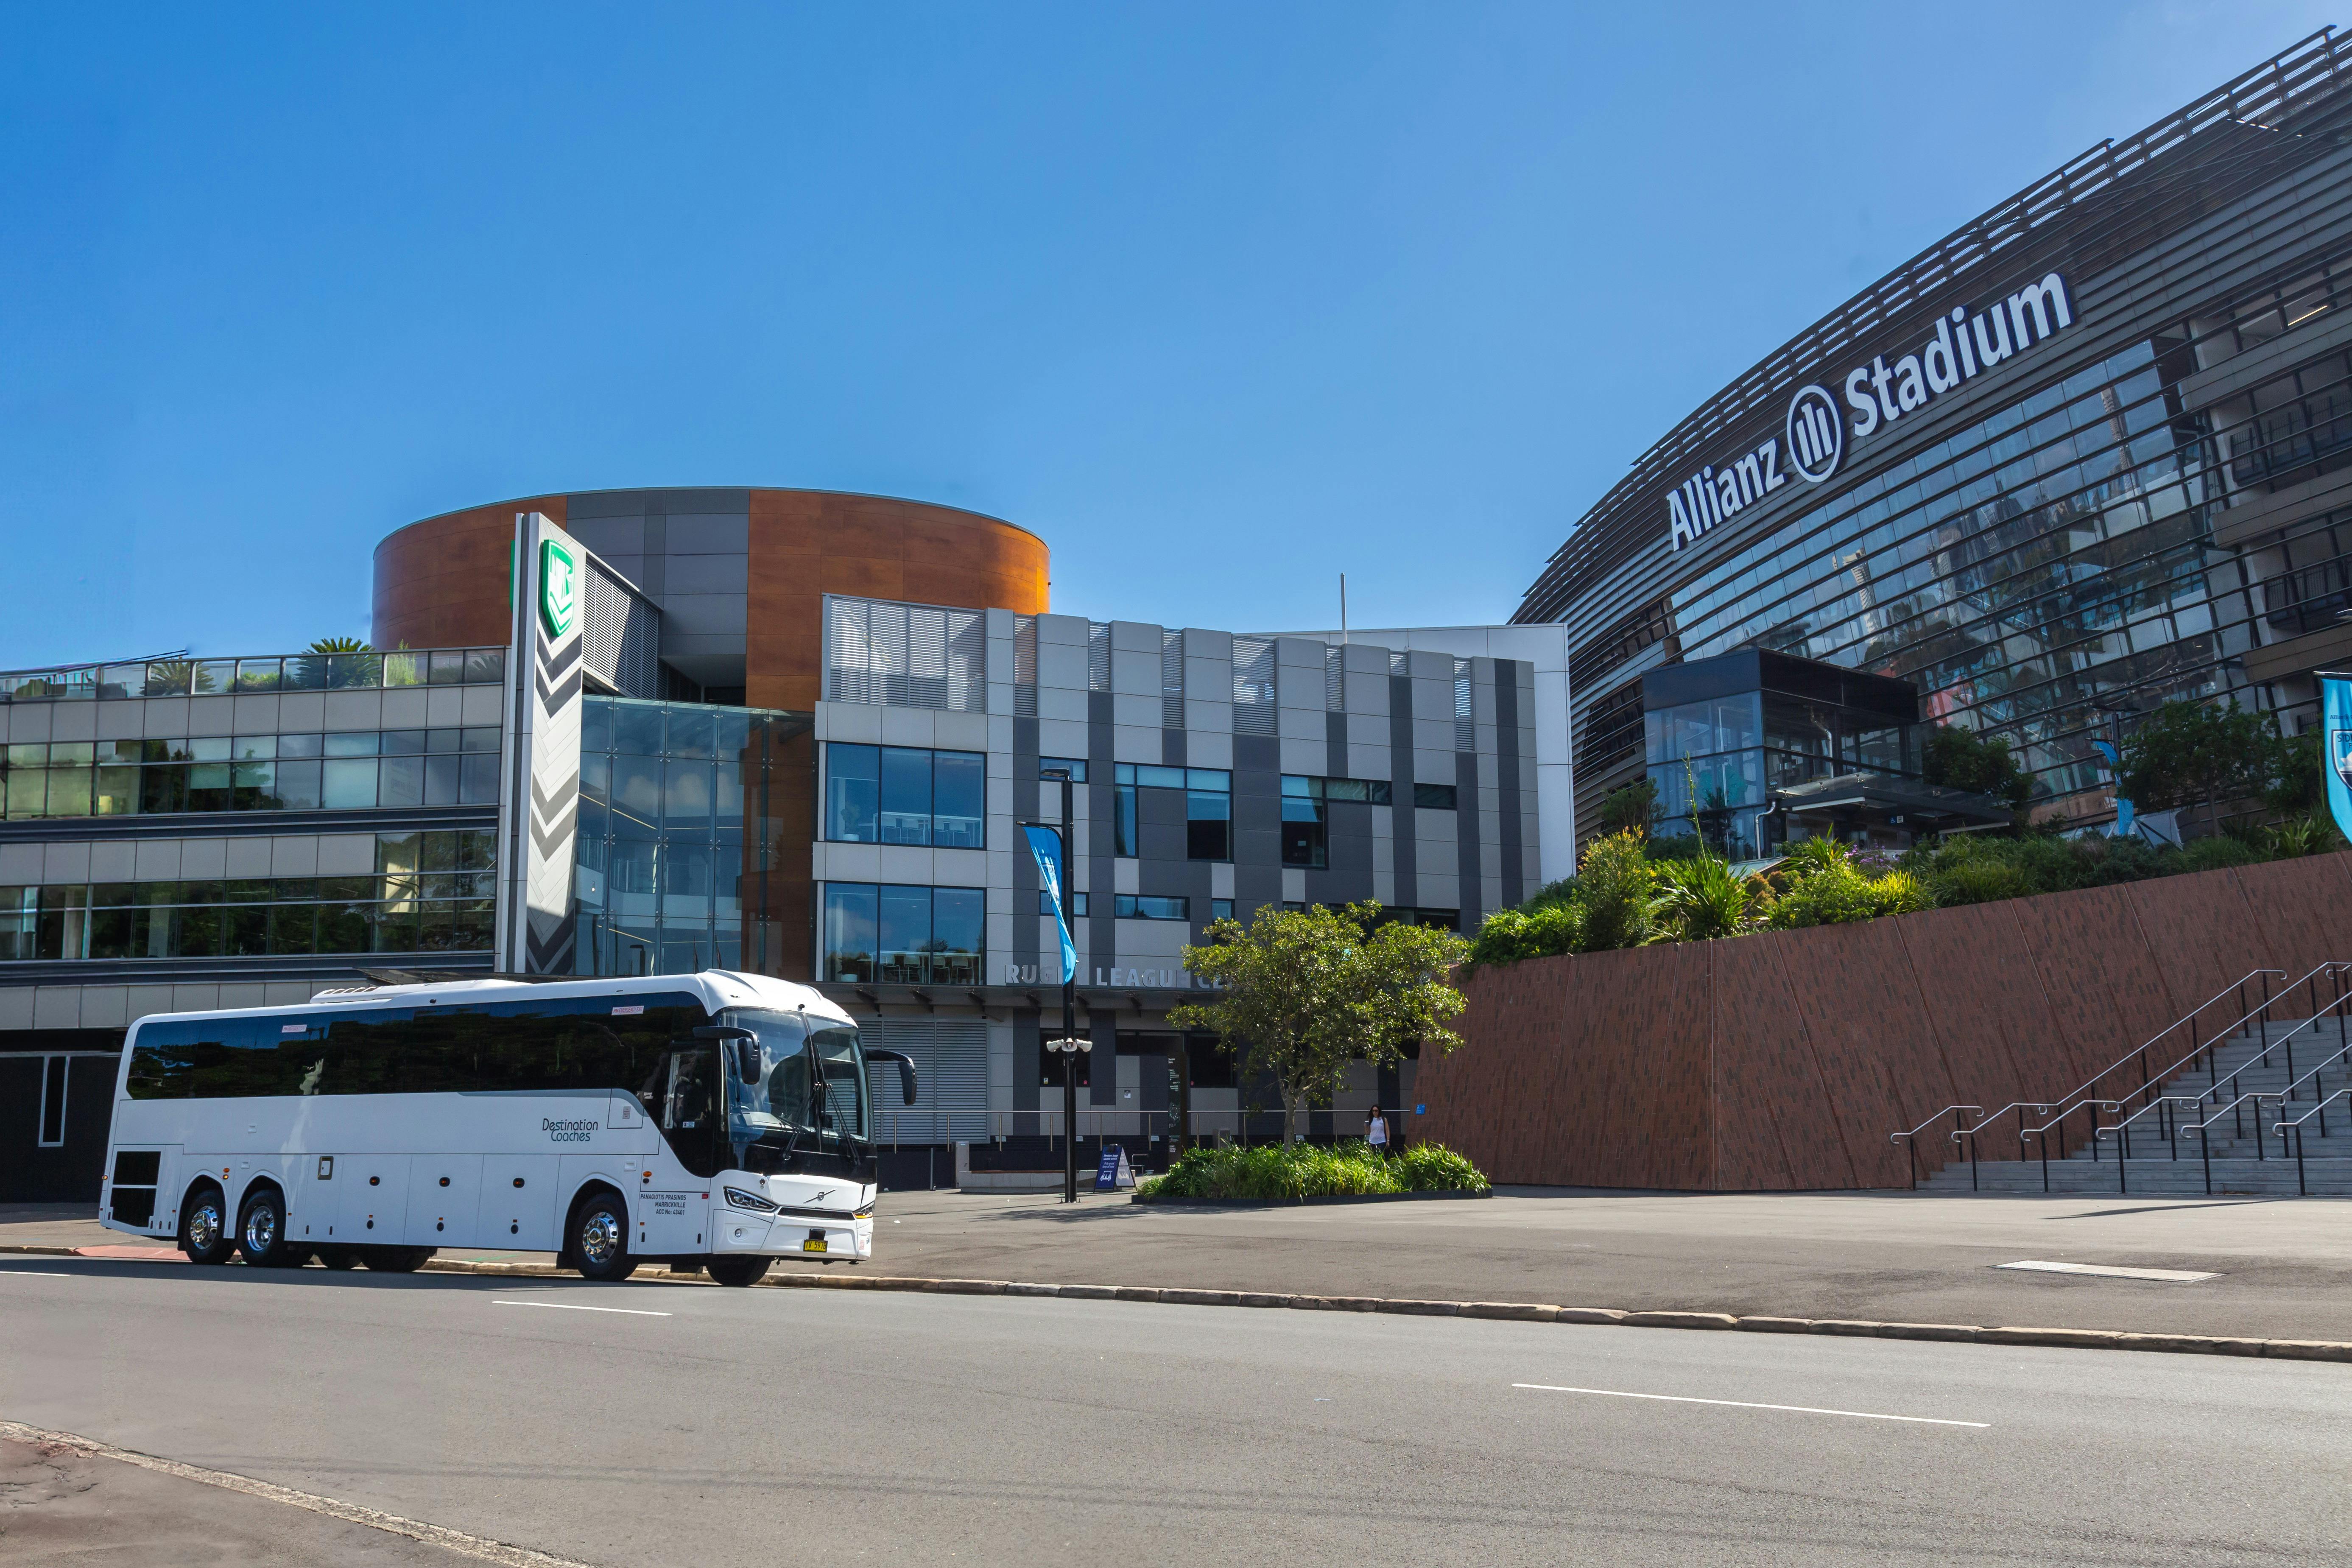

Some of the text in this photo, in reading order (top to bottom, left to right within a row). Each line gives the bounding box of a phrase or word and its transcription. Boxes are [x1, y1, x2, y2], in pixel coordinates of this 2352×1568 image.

[1666, 273, 2071, 552] Allianz Stadium
[1006, 964, 1087, 985] RUG
[542, 1118, 598, 1131] Destination
[551, 1129, 591, 1141] Coaches
